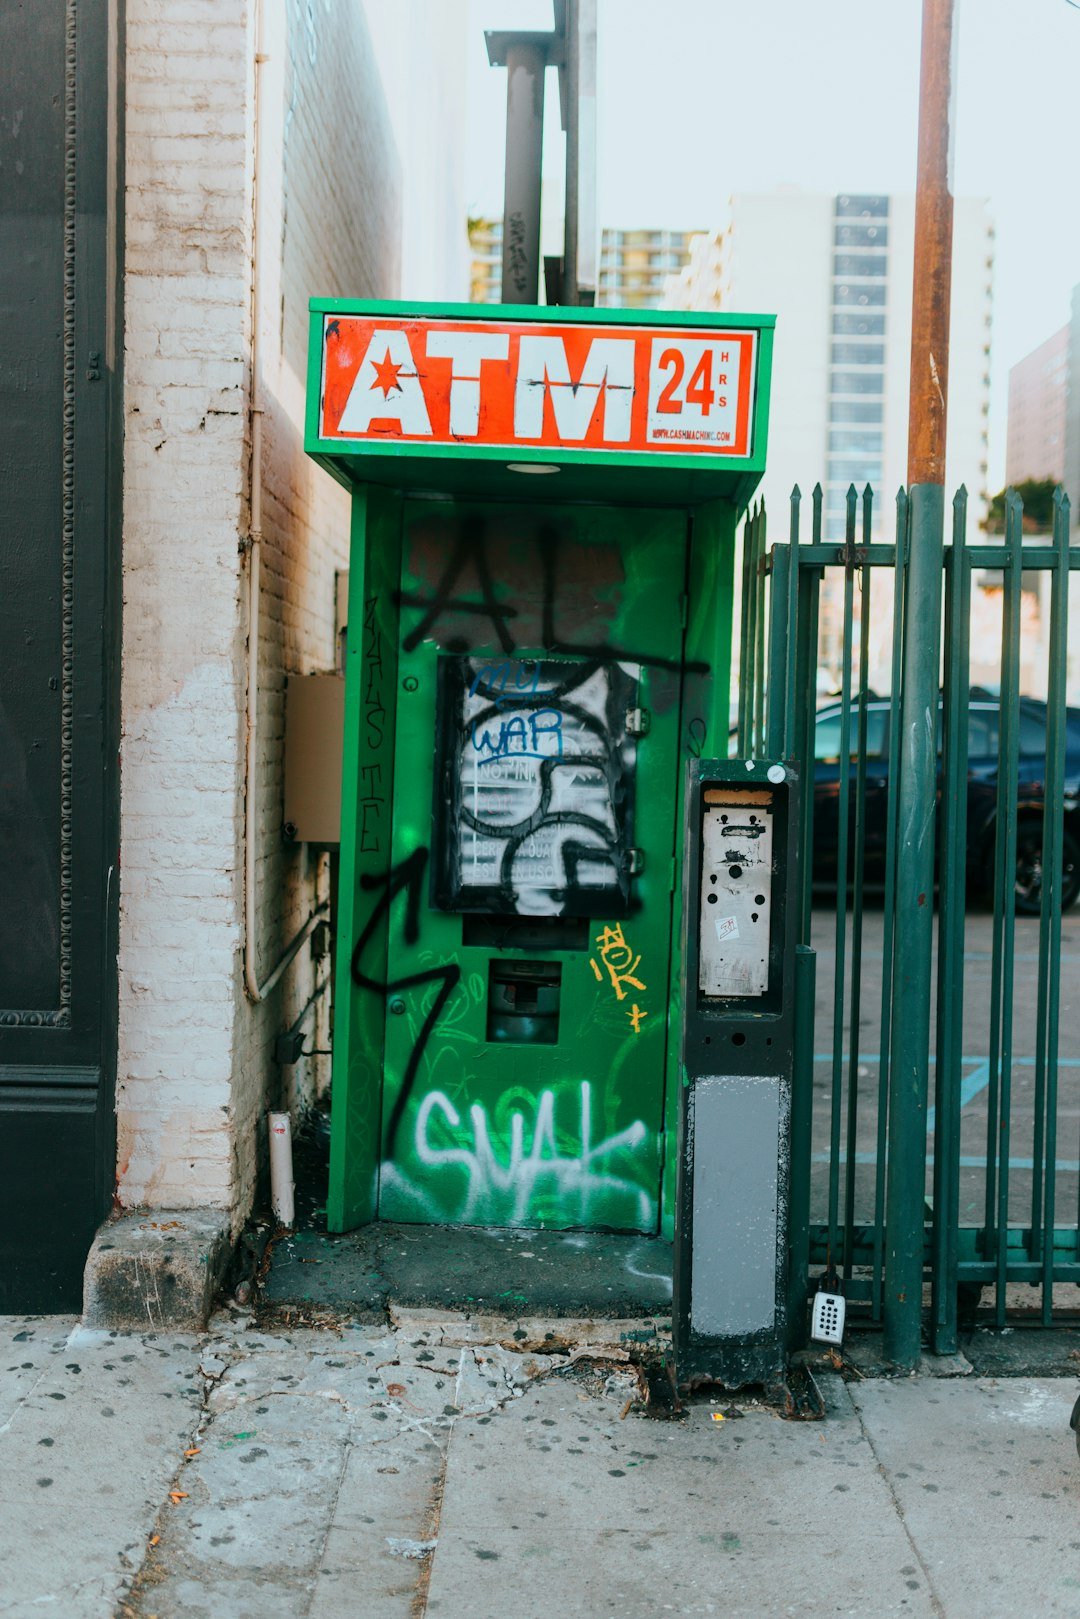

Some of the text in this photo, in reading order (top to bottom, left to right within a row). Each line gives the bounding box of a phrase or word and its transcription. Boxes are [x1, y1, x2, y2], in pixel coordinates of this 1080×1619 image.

[337, 329, 637, 443] ATM
[656, 347, 715, 417] 24
[472, 708, 564, 759] WAR
[480, 763, 509, 780] NOT
[515, 762, 529, 781] IN
[528, 864, 554, 880] USO
